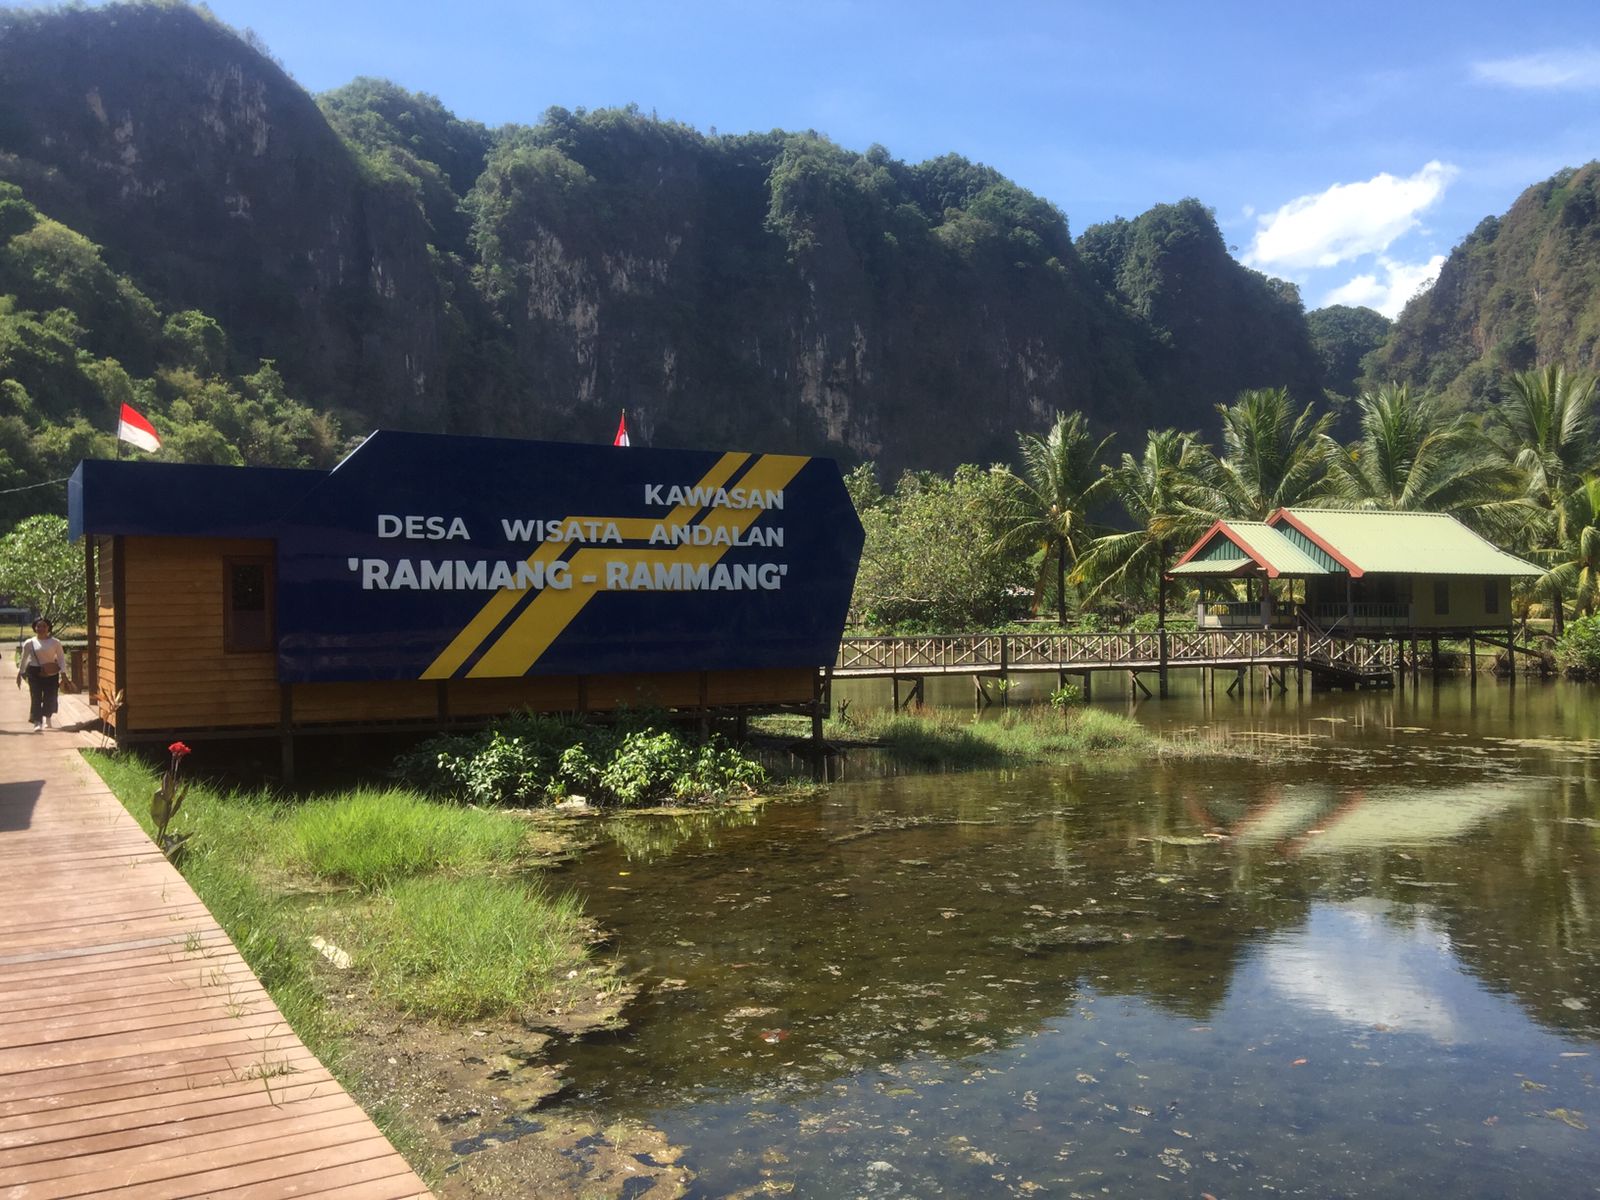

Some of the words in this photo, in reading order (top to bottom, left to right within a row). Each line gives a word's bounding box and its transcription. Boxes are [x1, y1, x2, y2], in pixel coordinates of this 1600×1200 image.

[644, 484, 785, 510] KAWASAN
[377, 514, 470, 540] DESA
[501, 518, 623, 544] WISATA
[649, 524, 785, 547] ANDALAN
[581, 573, 598, 584] -
